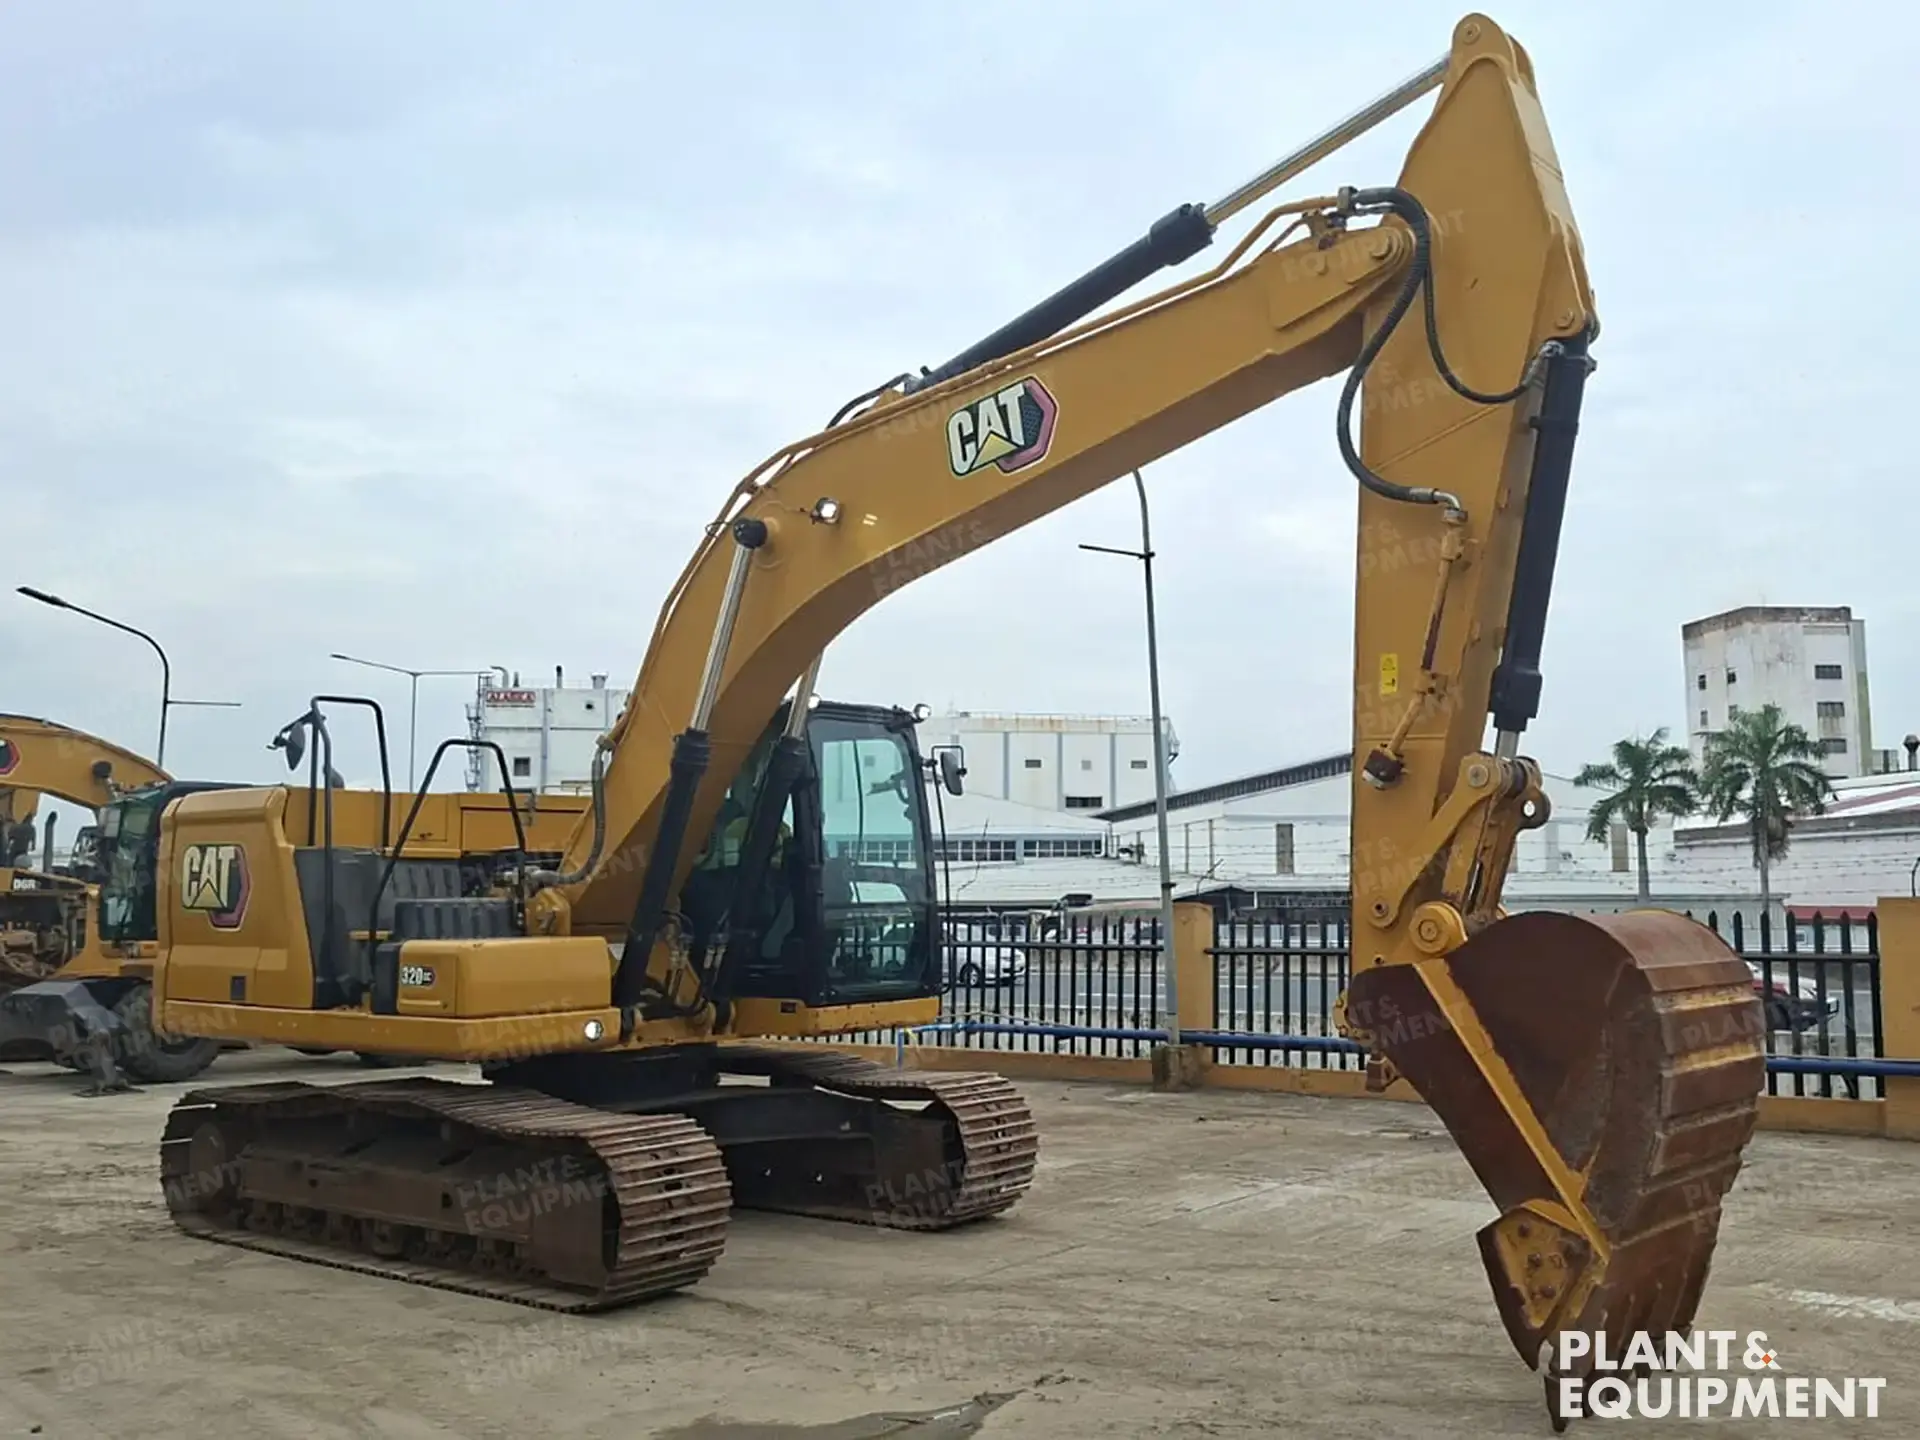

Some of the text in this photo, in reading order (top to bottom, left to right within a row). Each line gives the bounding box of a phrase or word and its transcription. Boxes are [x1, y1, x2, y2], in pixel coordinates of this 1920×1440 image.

[948, 383, 1025, 474] CAT
[182, 845, 236, 908] CAT
[401, 966, 423, 985] 320
